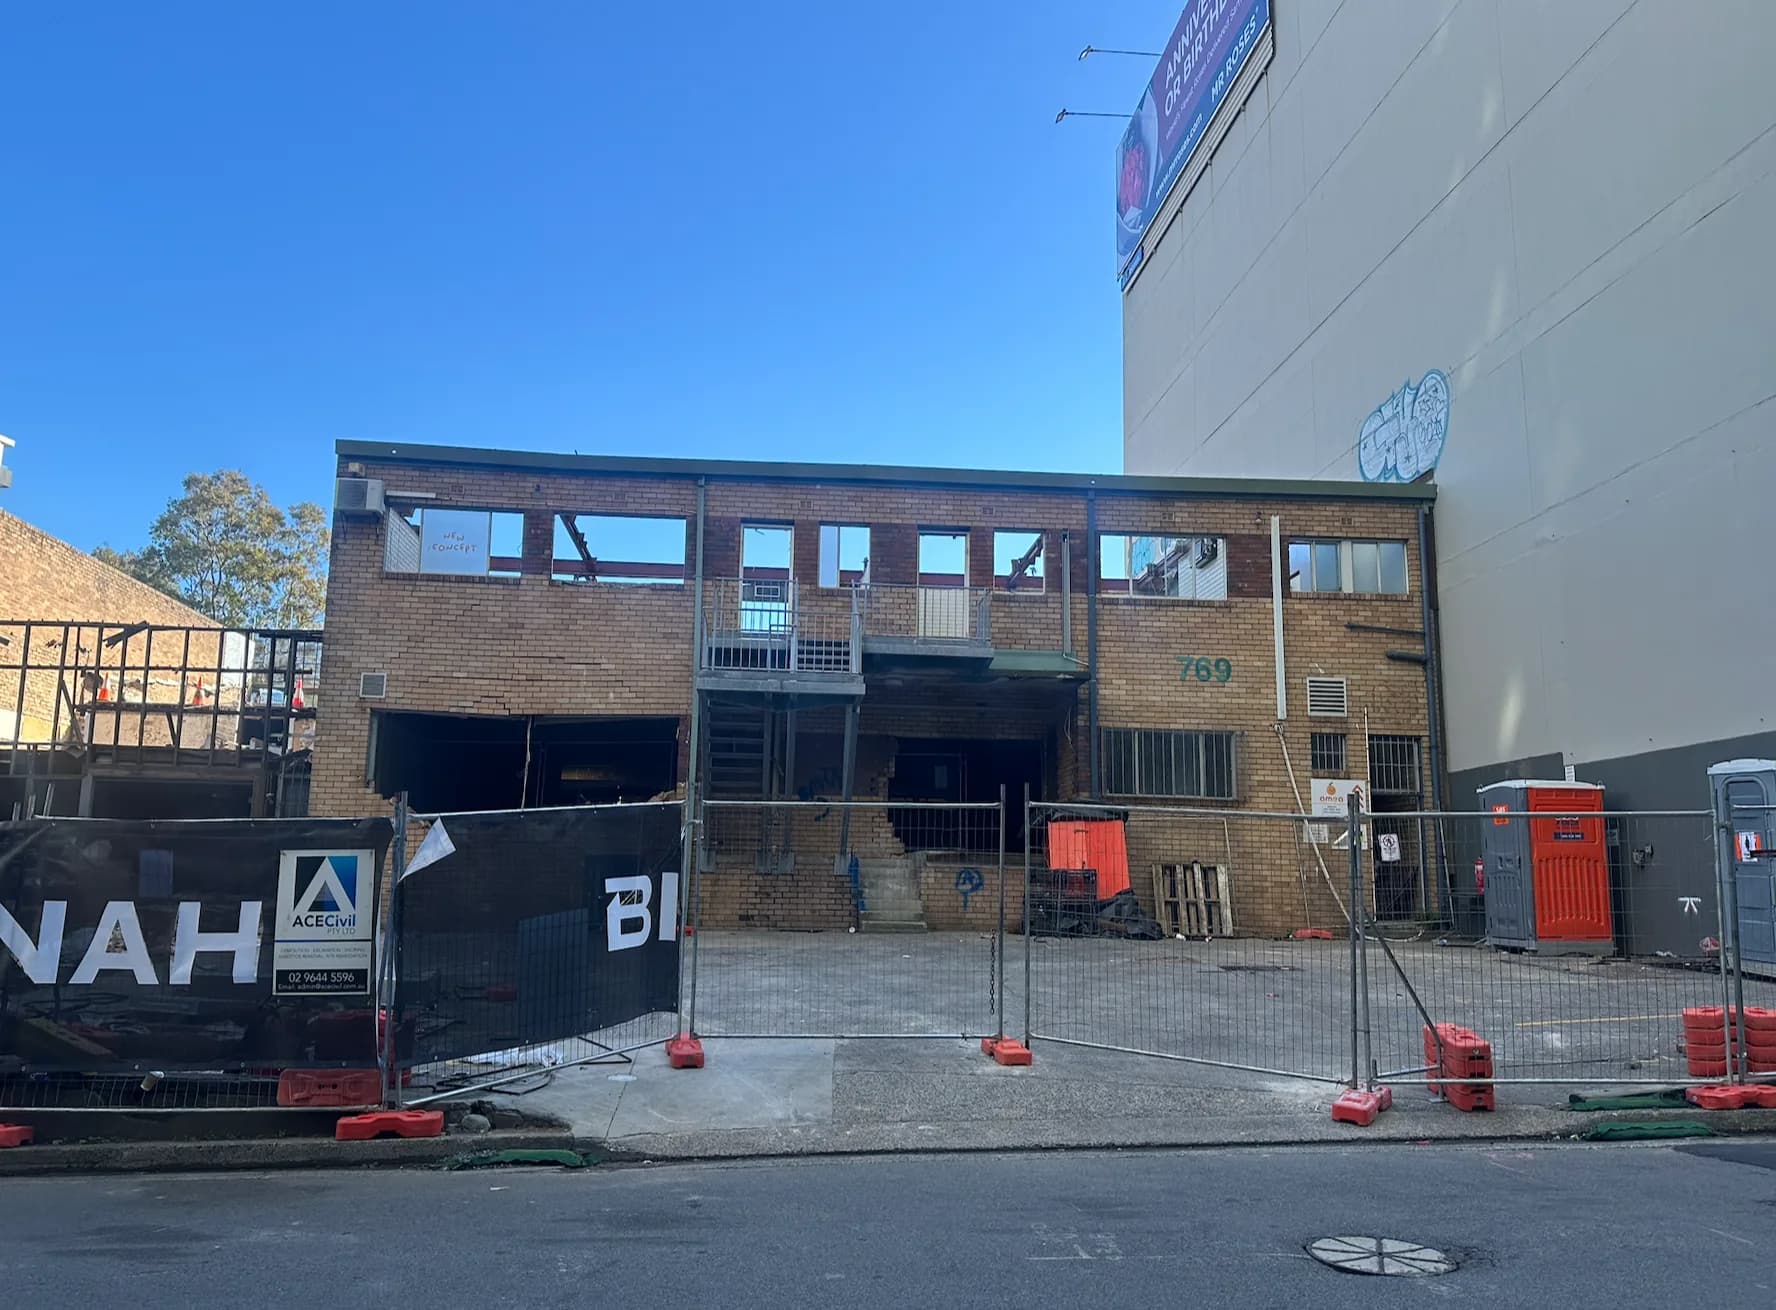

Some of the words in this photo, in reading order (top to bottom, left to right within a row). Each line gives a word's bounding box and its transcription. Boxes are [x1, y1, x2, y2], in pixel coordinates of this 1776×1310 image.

[1211, 71, 1224, 103] MR
[1226, 14, 1256, 77] ROSES
[1165, 74, 1181, 117] OR
[1176, 656, 1232, 682] 769
[292, 914, 356, 928] ACECivil
[288, 972, 302, 983] 02
[304, 972, 328, 983] 9644
[331, 972, 355, 983] 5596
